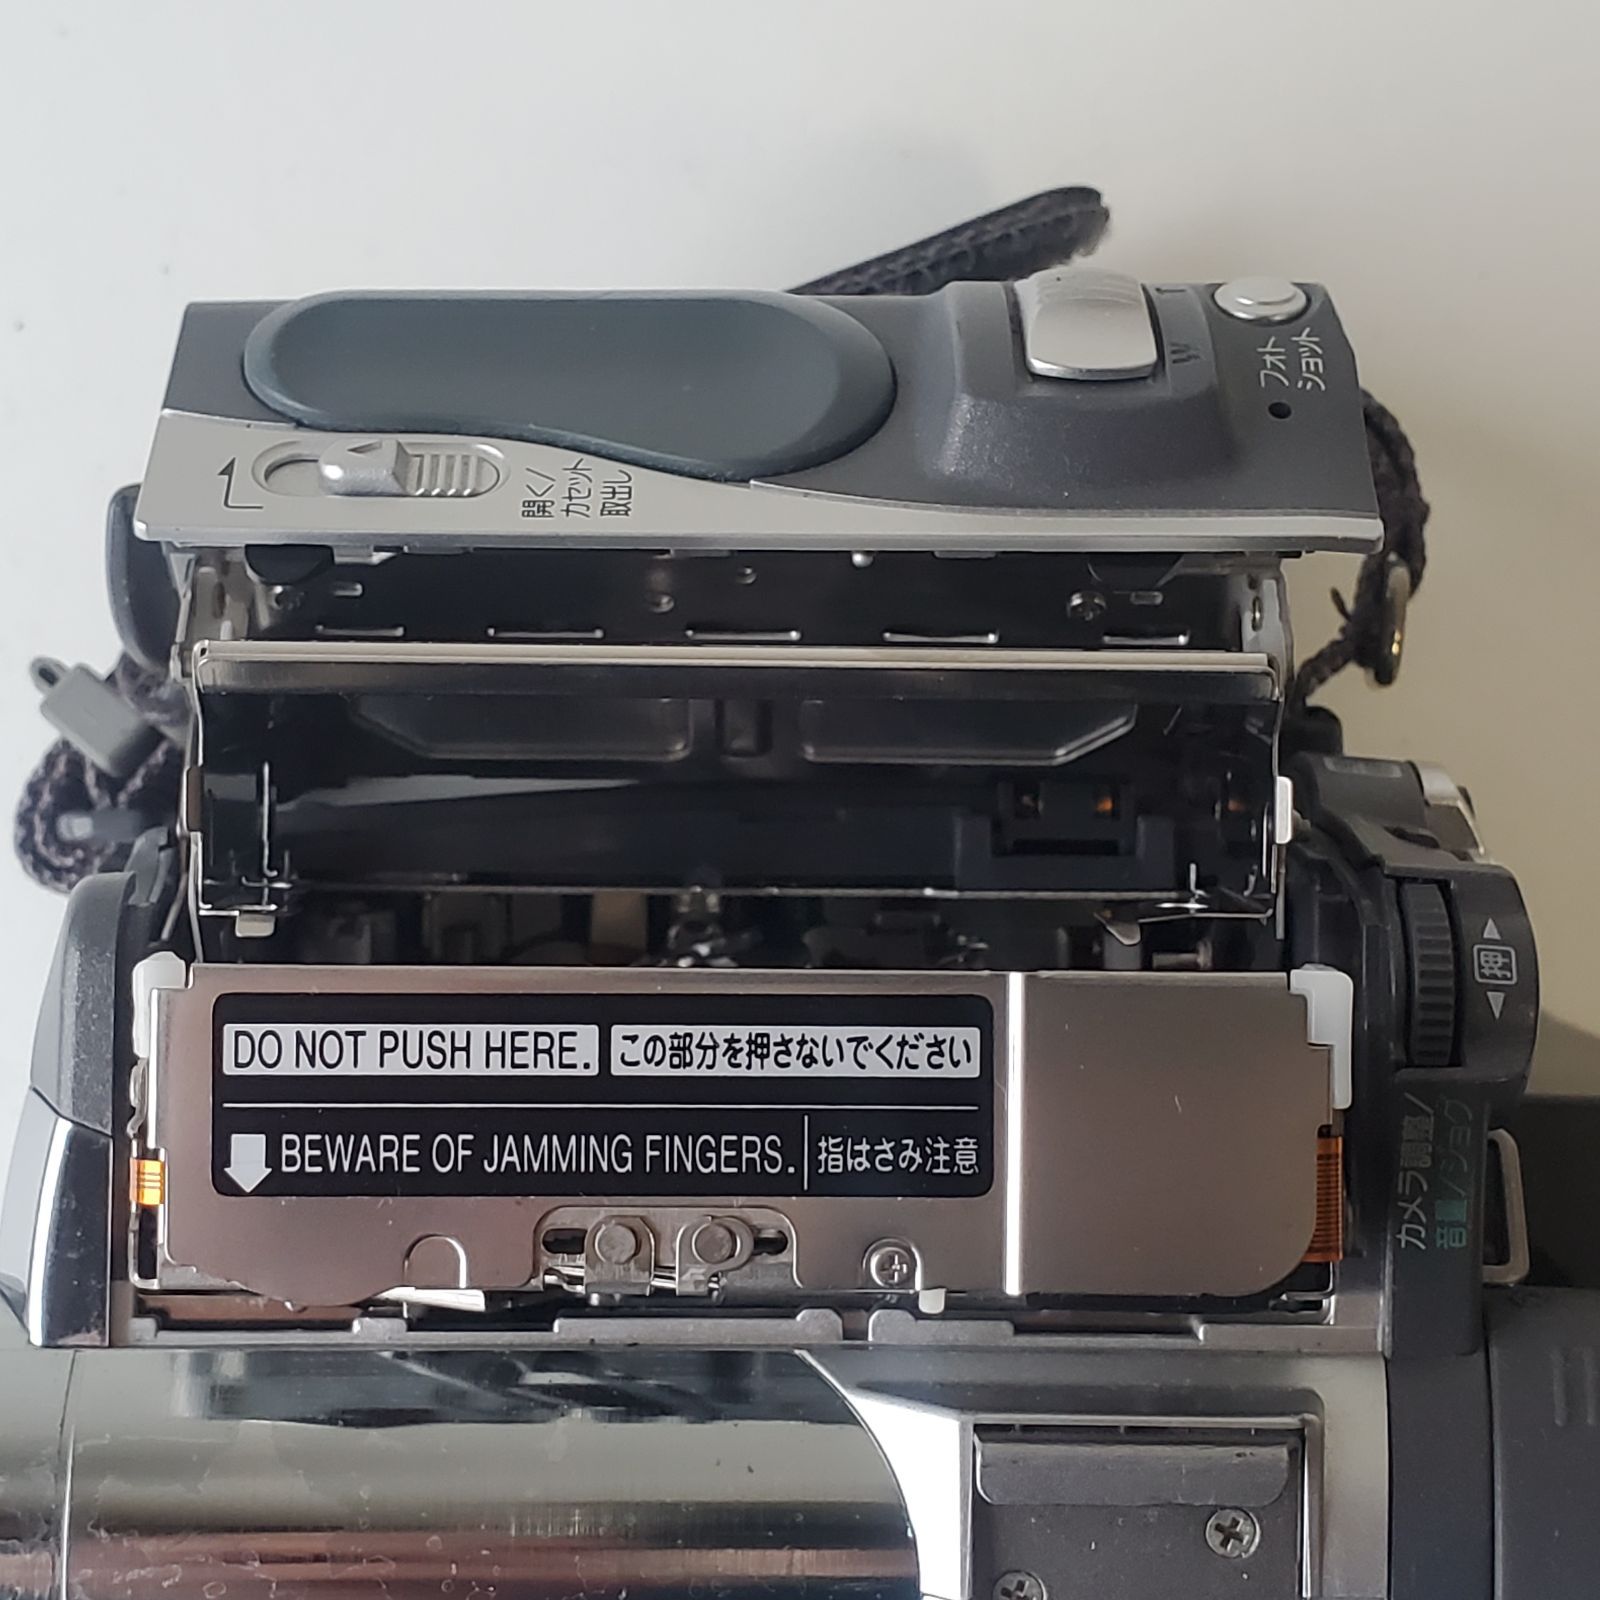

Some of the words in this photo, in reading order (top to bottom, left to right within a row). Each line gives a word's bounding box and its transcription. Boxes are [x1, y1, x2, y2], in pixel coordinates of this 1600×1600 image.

[1256, 336, 1290, 388] フォト
[1291, 327, 1326, 391] ショット
[560, 458, 592, 518] カセット
[600, 469, 632, 516] 取出し
[1480, 951, 1511, 978] 押
[234, 1029, 283, 1069] DO
[295, 1029, 367, 1069] NOT
[379, 1029, 472, 1070] PUSH
[486, 1030, 591, 1070] HERE.
[619, 1031, 972, 1071] この部分を押さないでください
[281, 1133, 421, 1173] BEWARE
[432, 1134, 474, 1173] OF
[483, 1134, 632, 1173] JAMMING
[646, 1134, 795, 1174] FINGERS.
[817, 1136, 978, 1174] 指はさみ注意
